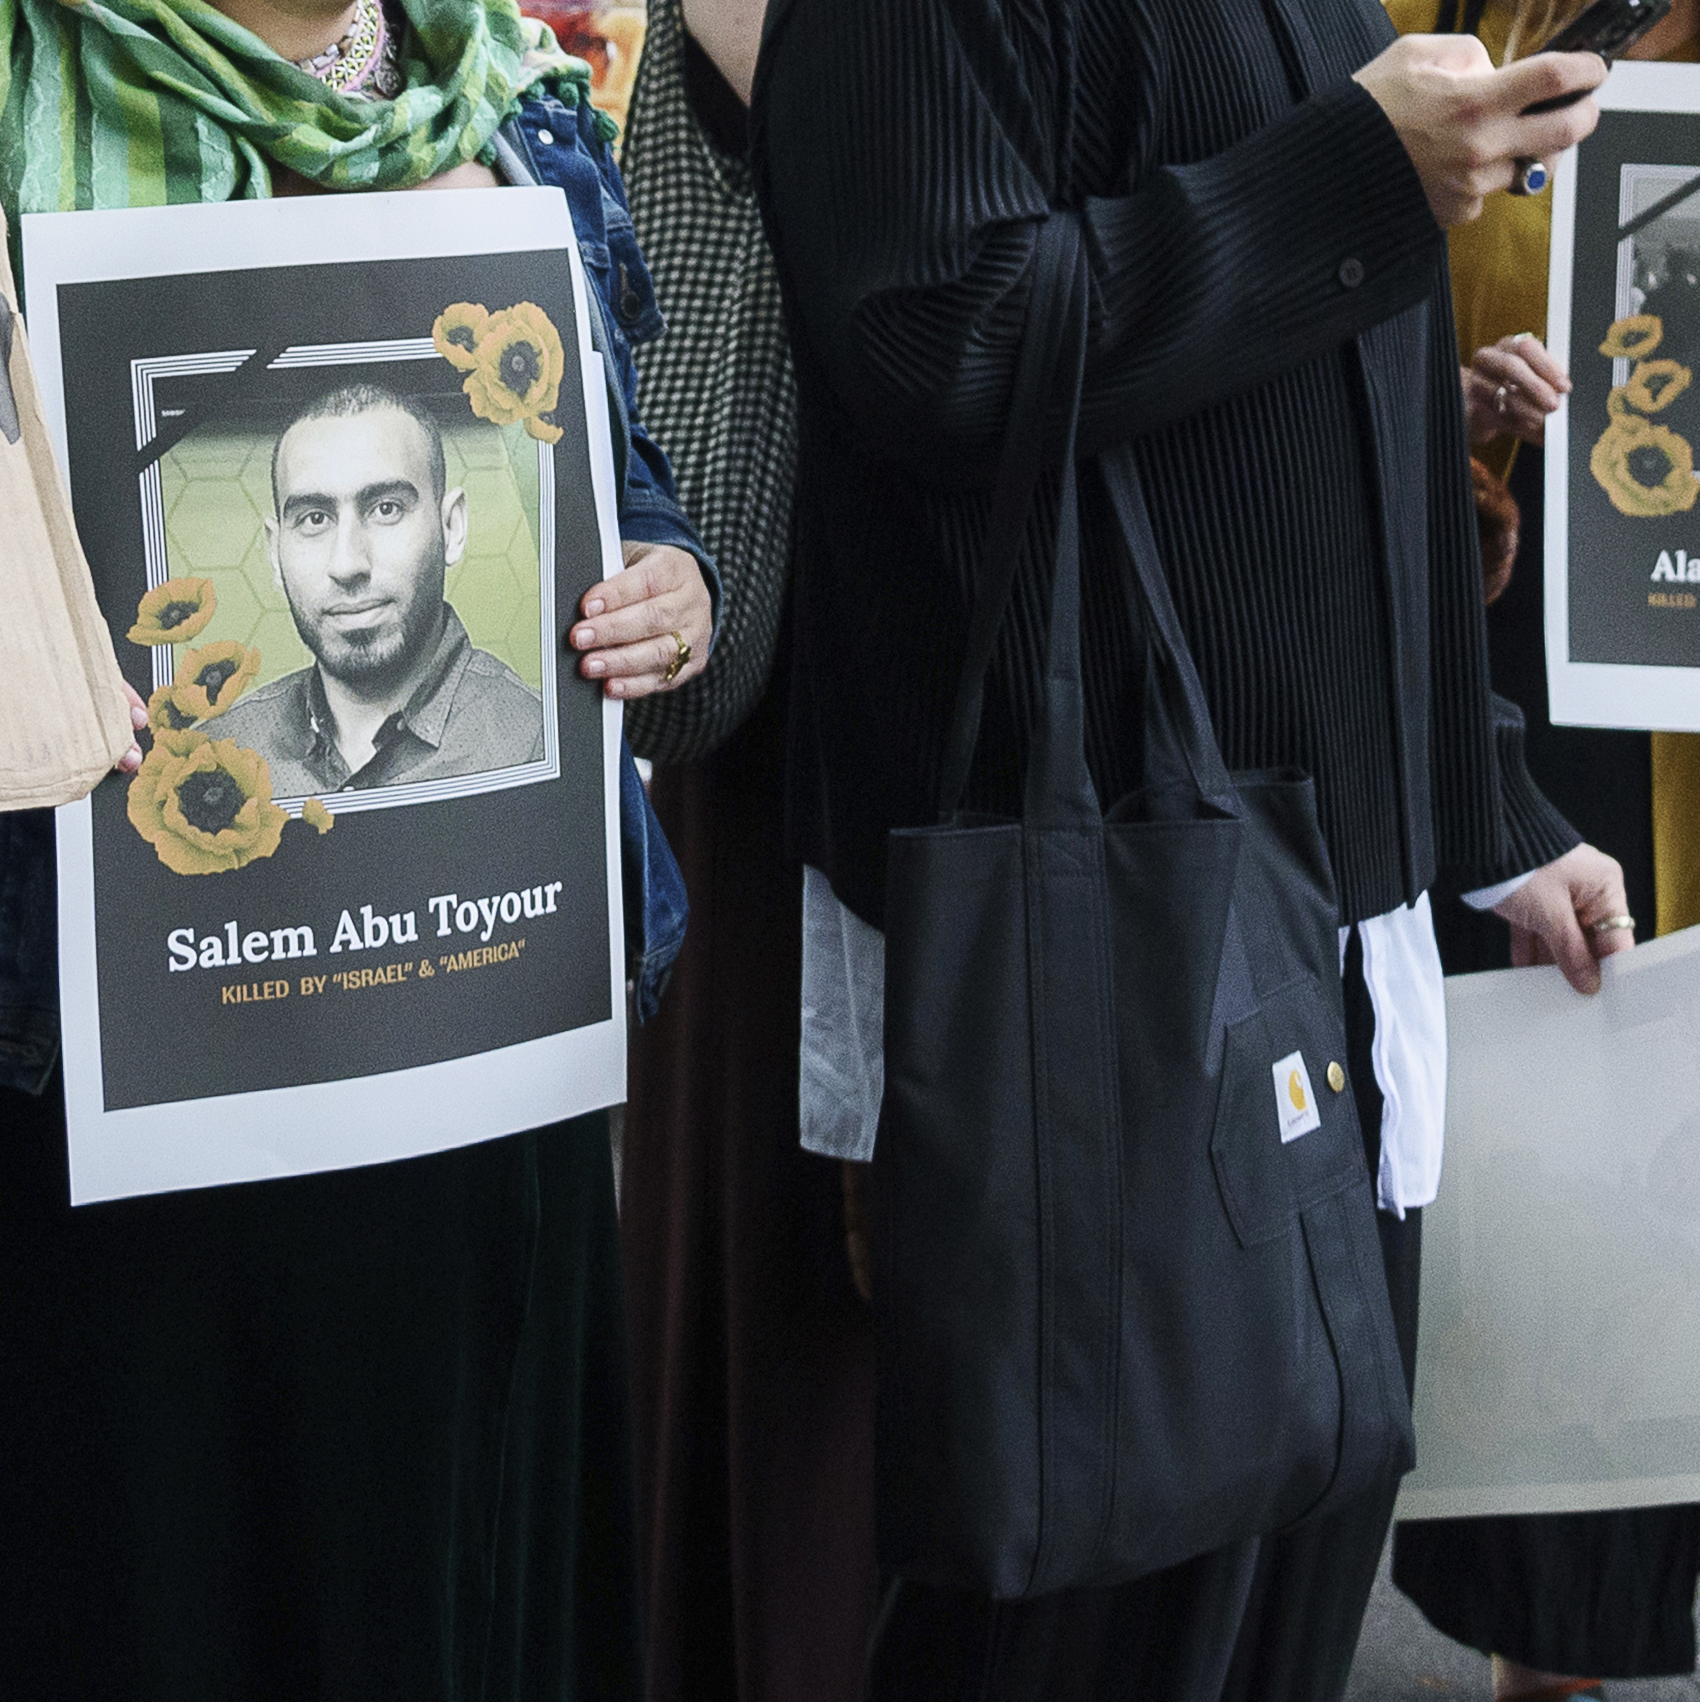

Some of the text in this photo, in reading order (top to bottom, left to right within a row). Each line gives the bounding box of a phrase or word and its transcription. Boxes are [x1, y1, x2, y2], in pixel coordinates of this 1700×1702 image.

[167, 881, 563, 972] Salem Abu Toyour
[221, 980, 290, 1004] KILLED
[300, 975, 327, 996] BY
[418, 960, 435, 978] &
